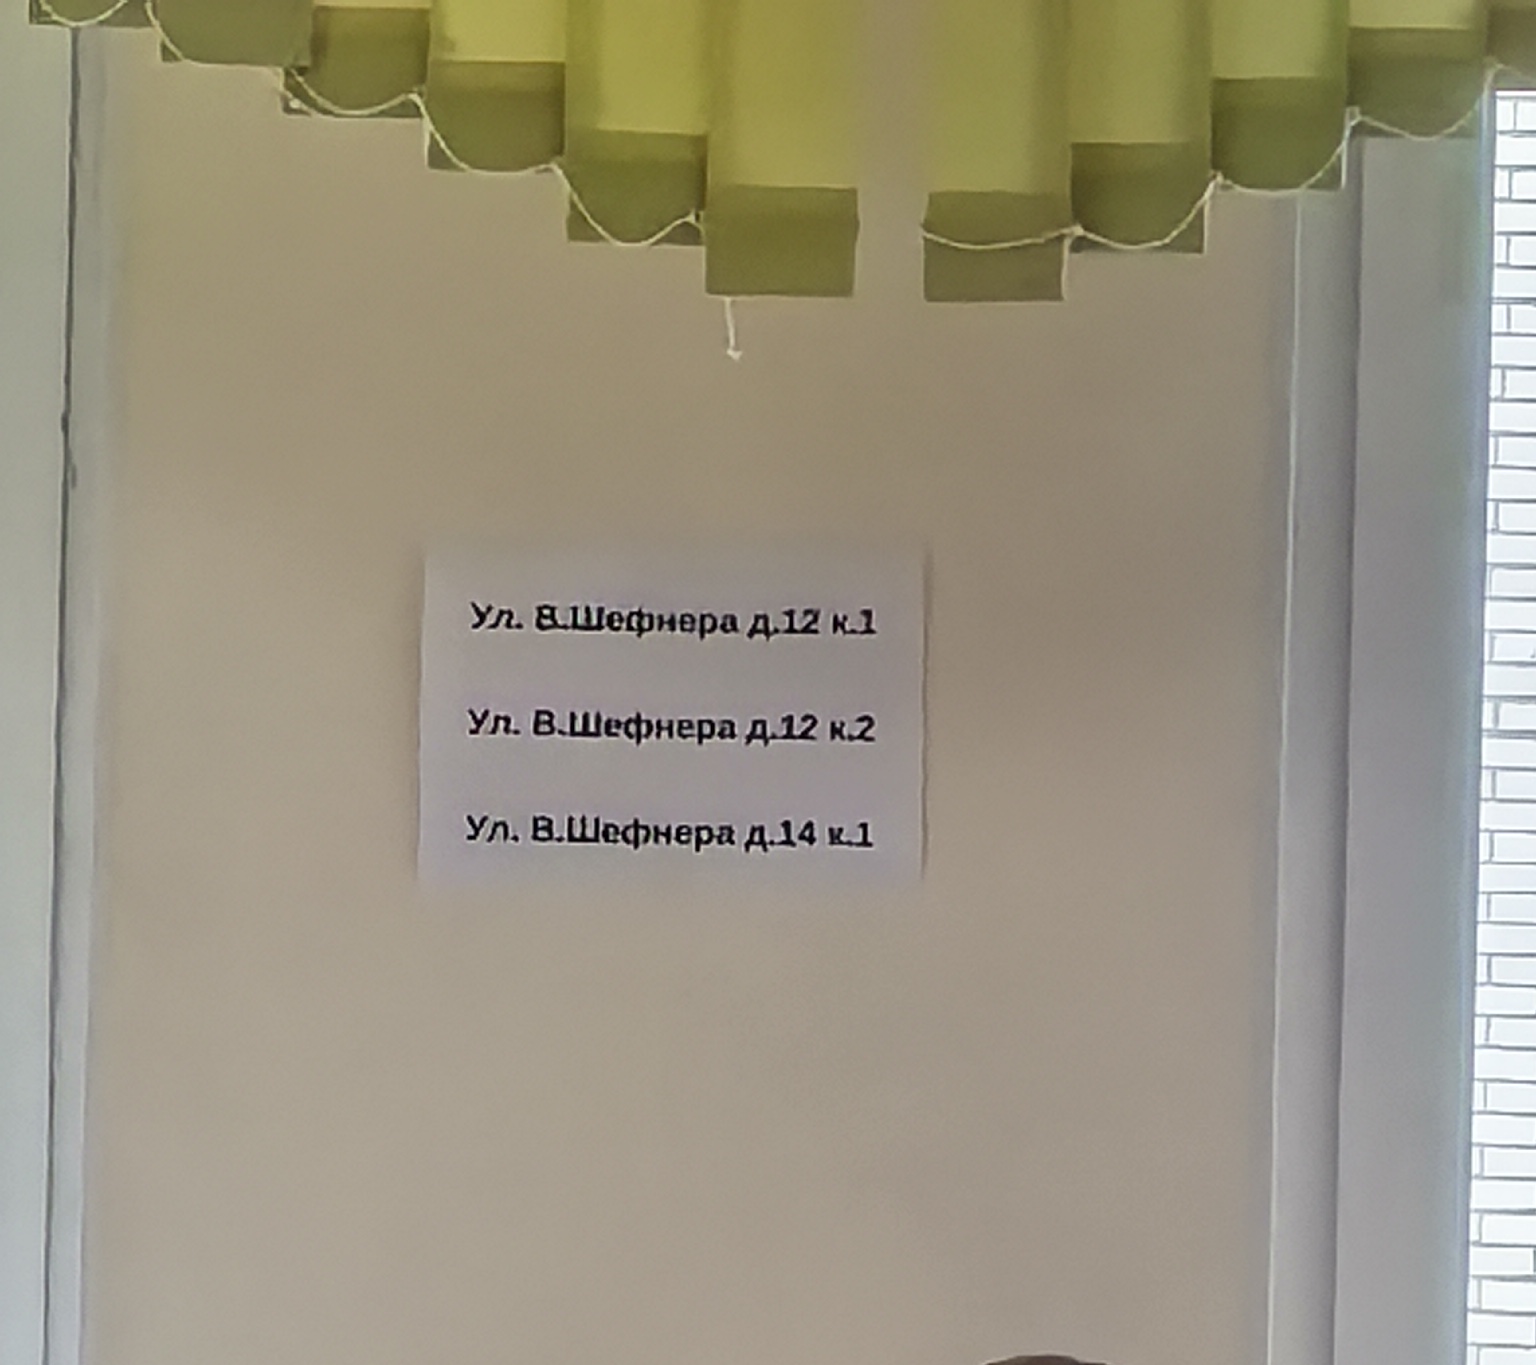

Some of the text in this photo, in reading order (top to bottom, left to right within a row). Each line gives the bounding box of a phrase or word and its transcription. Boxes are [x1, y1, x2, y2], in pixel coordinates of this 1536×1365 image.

[470, 602, 877, 641] Ул. В.Шефнера д.12 к.1
[468, 708, 875, 747] Ул. В.Шефнера д.12 к.2
[466, 814, 873, 853] Ул. В.Шефнера д.14 к.1
